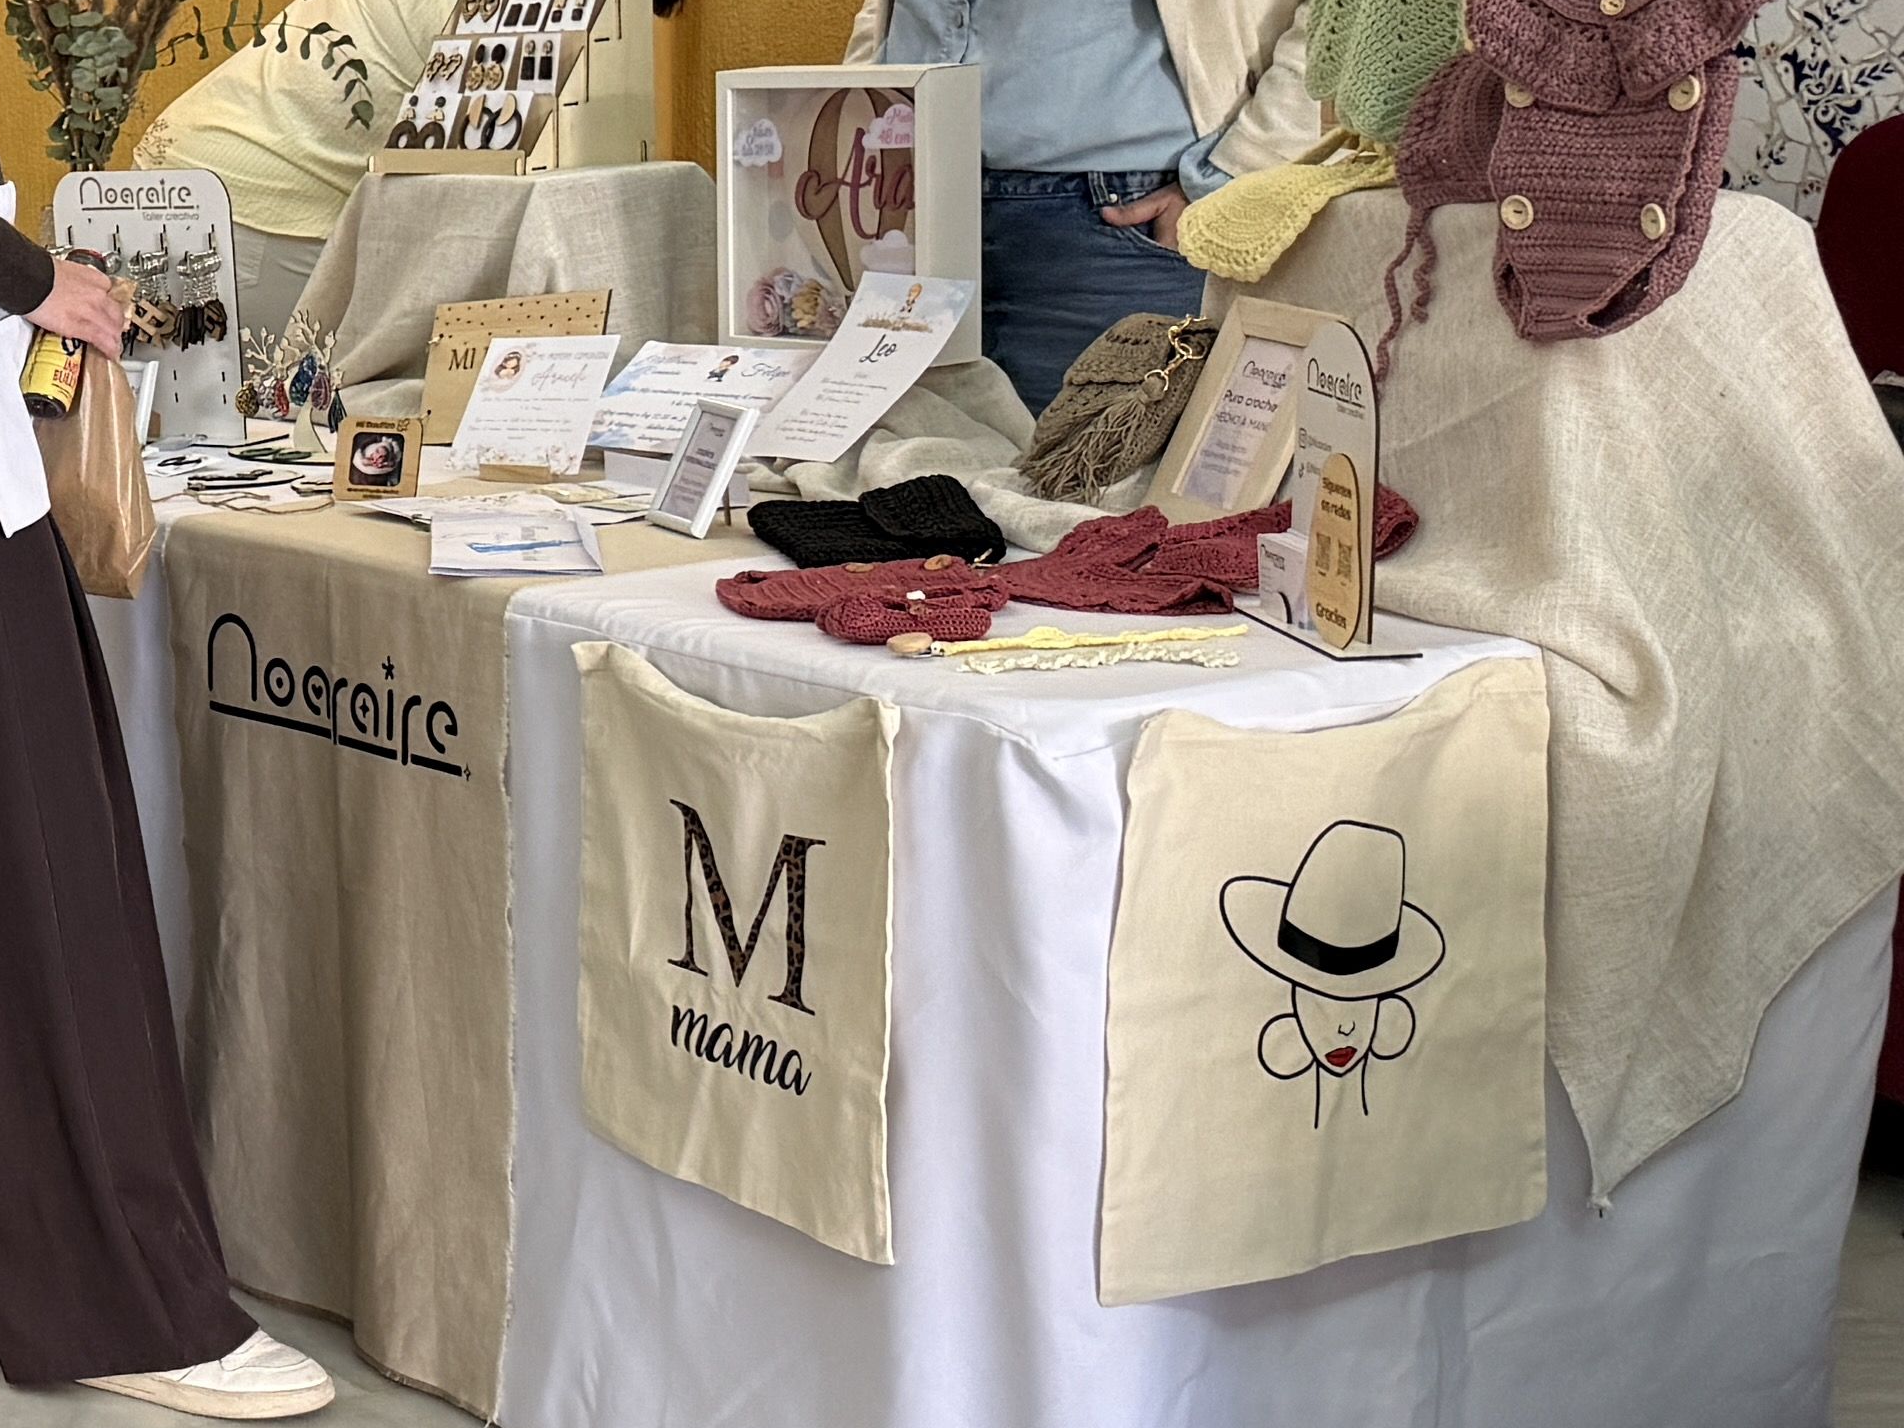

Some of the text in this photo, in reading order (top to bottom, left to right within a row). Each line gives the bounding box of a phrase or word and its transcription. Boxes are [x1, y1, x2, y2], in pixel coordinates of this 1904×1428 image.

[208, 613, 458, 765] Noaraire
[667, 798, 827, 1015] M
[670, 1004, 812, 1096] mama
